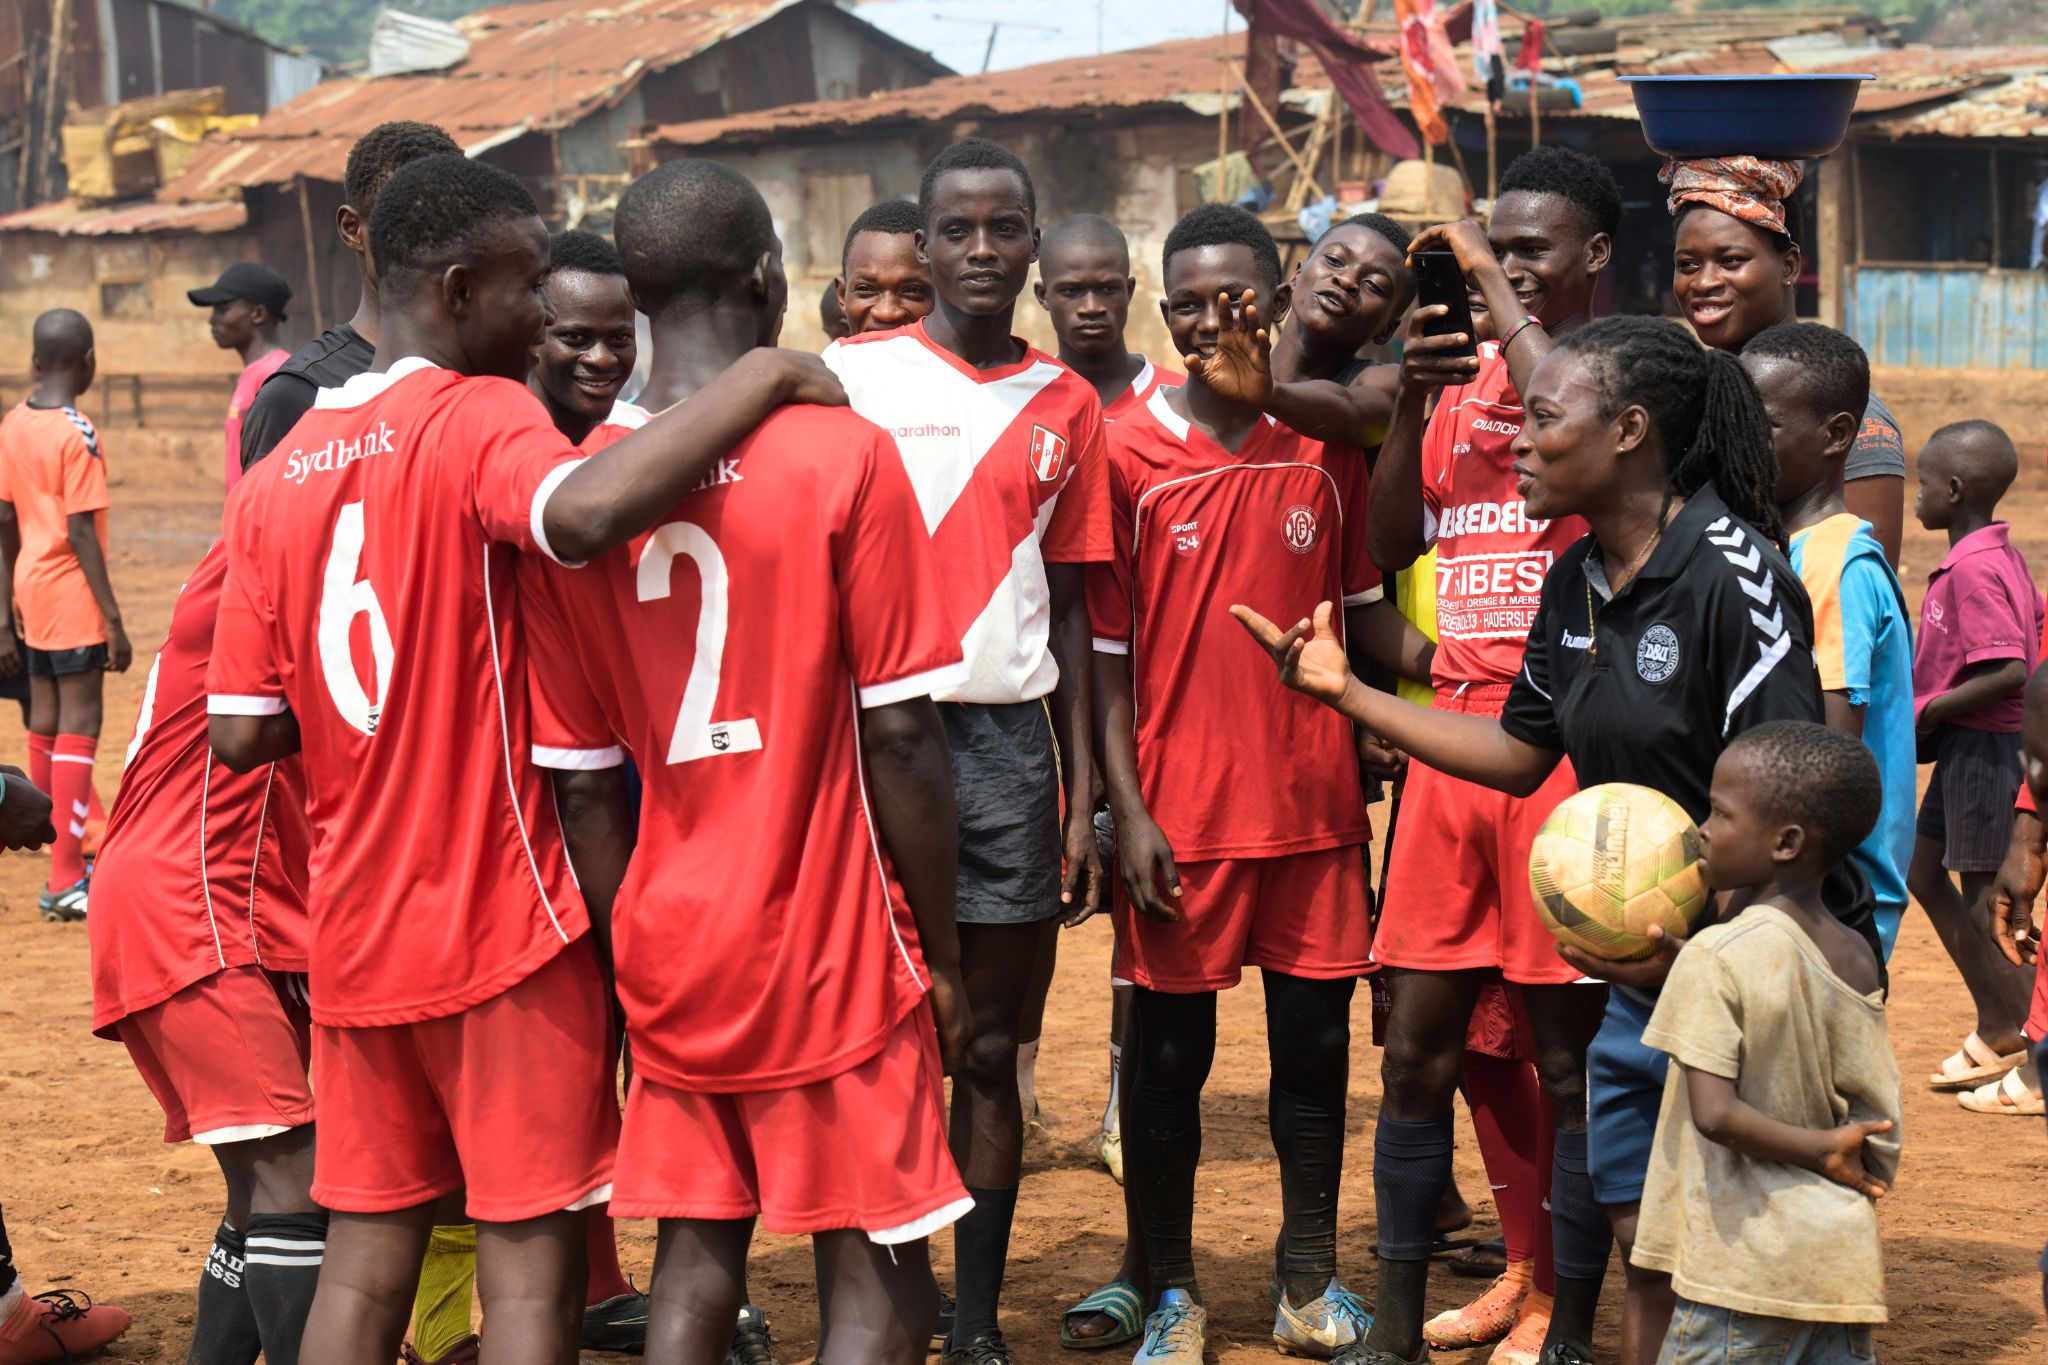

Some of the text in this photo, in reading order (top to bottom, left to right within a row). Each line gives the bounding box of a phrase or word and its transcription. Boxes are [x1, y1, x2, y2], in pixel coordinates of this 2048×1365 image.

[1171, 521, 1198, 534] SPORT
[1176, 534, 1200, 551] 24
[1467, 596, 1498, 608] DRENGE
[1500, 595, 1507, 605] &
[317, 498, 396, 736] 6
[1483, 610, 1537, 629] HADERSLE
[637, 520, 763, 765] 2
[209, 1242, 245, 1273] BAD
[204, 1256, 241, 1289] ASS
